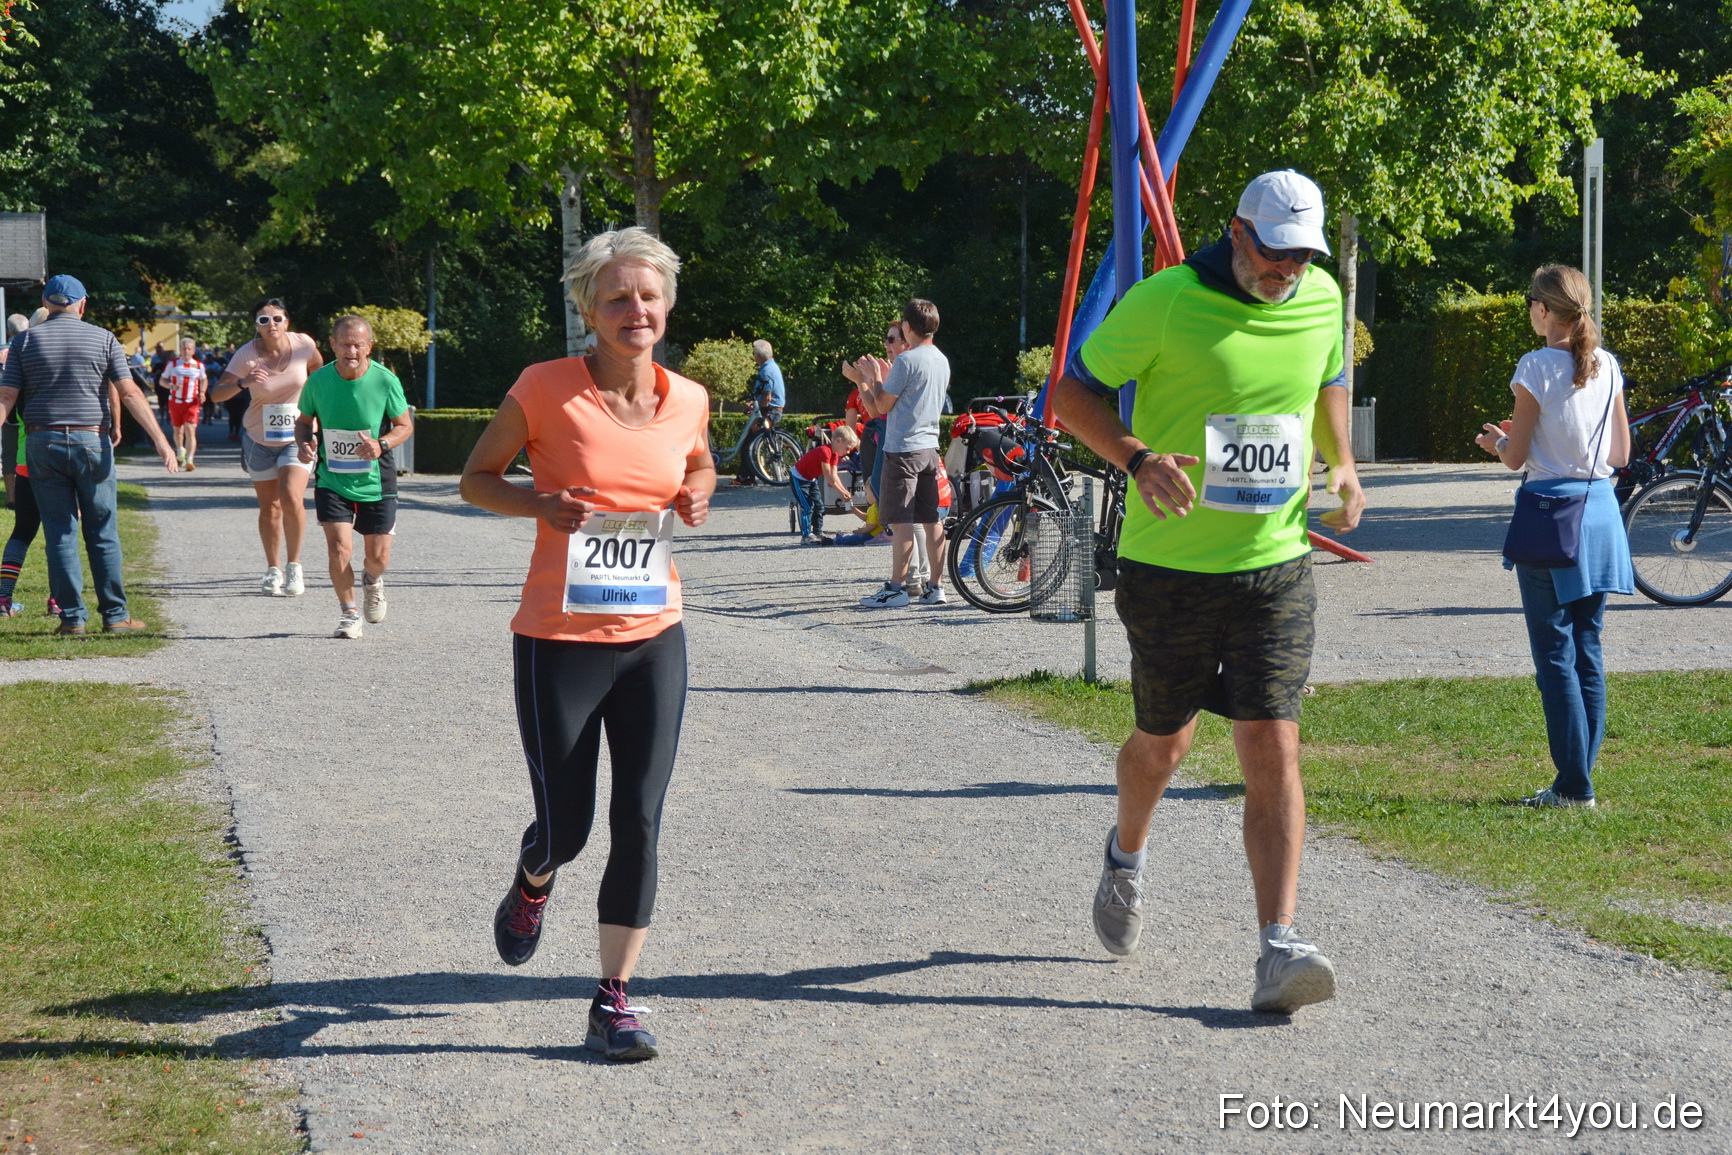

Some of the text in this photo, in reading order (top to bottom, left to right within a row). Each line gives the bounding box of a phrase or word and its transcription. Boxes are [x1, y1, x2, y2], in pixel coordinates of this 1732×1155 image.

[1237, 425, 1280, 434] BOCK
[1222, 443, 1290, 473] 2004
[1236, 490, 1272, 503] Nader
[603, 520, 648, 529] BOCK
[585, 537, 656, 569] 2007
[602, 589, 637, 602] Ulrike
